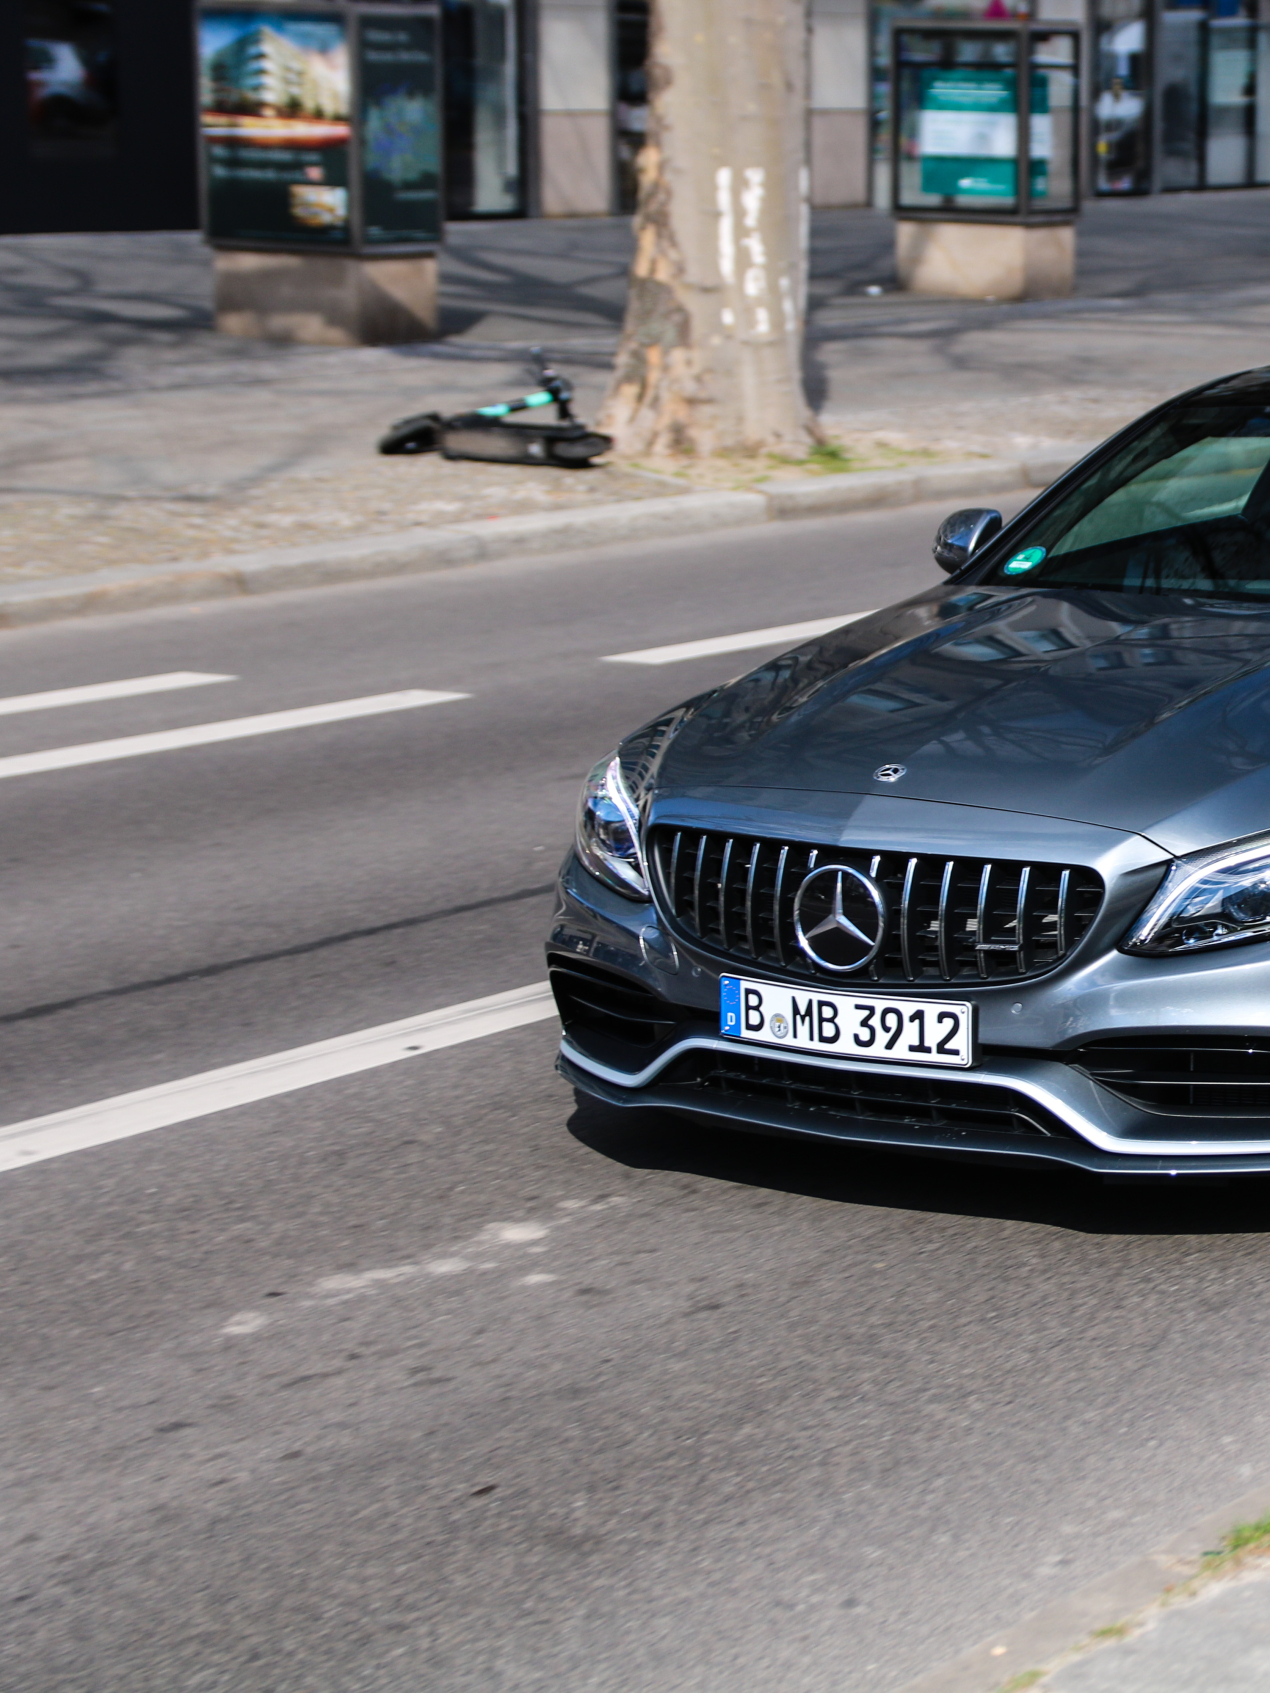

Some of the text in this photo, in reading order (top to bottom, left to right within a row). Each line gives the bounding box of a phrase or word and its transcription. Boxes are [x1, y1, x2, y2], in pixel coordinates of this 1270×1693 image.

[726, 988, 961, 1057] D B MB 3912
